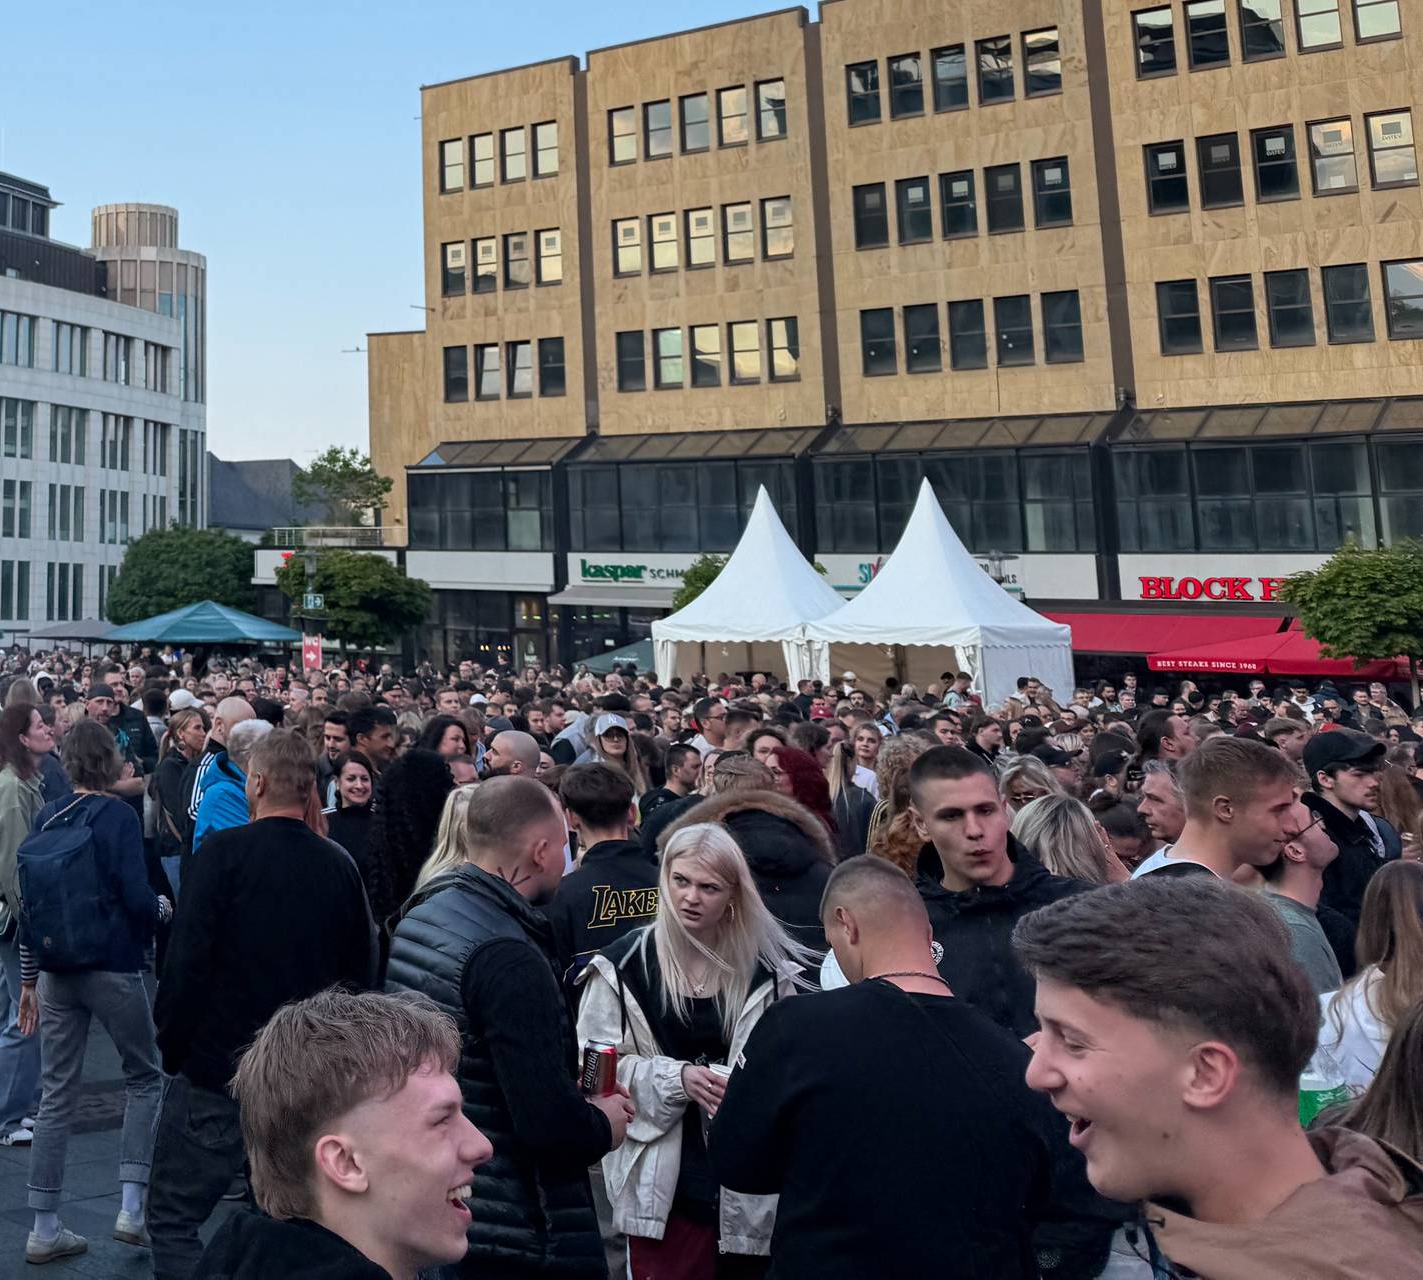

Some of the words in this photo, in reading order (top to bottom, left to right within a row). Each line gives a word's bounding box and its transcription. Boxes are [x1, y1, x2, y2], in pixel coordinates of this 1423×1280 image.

[580, 559, 647, 582] kaspar
[1139, 577, 1254, 600] BLOCK
[1211, 661, 1237, 669] SINCE
